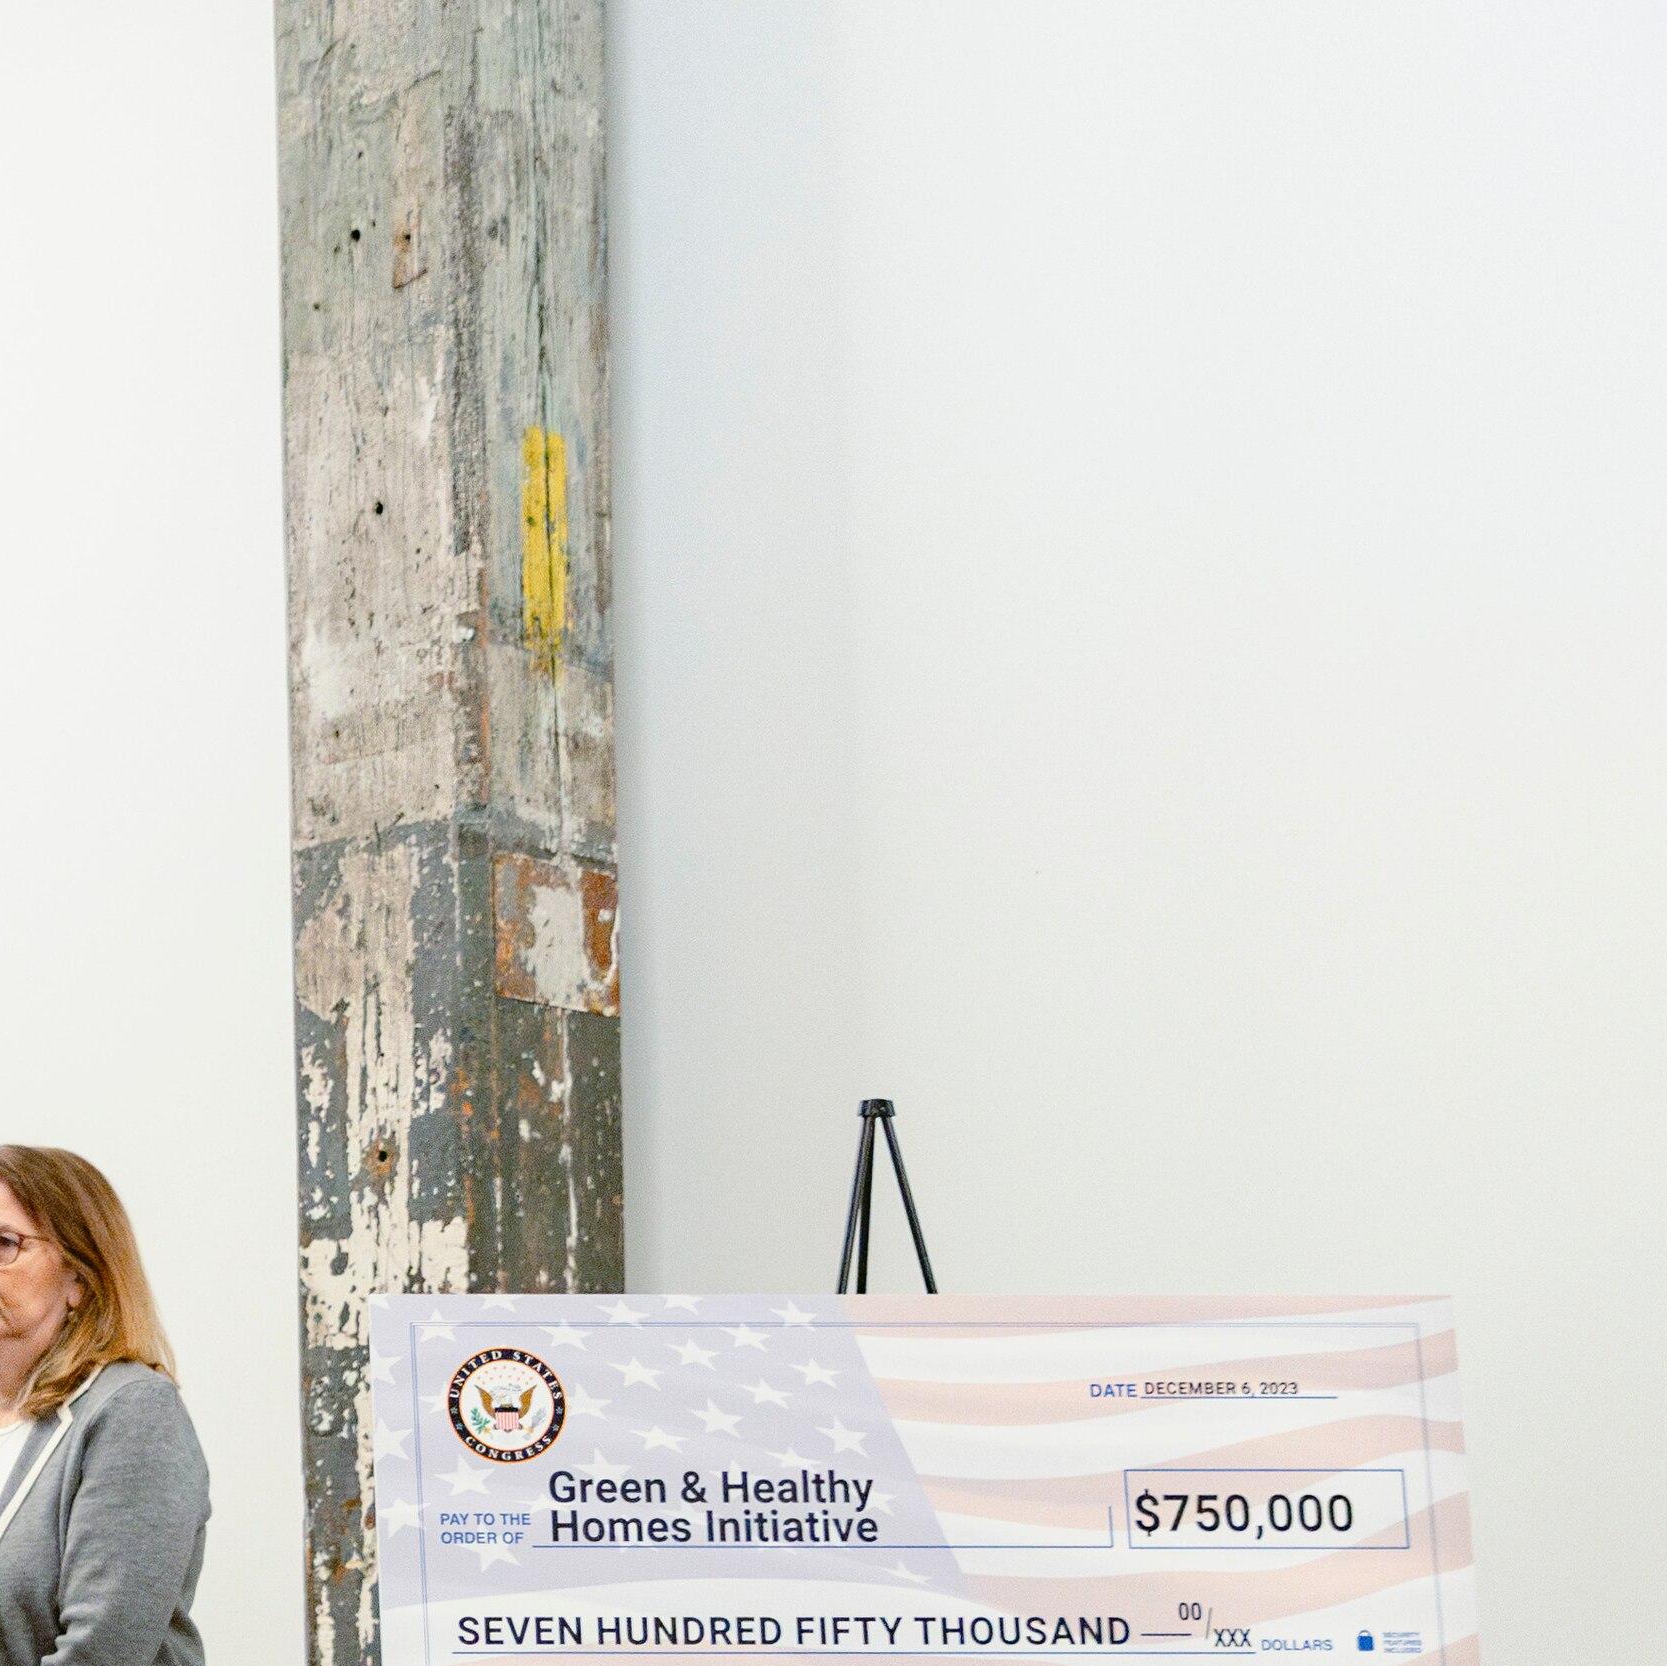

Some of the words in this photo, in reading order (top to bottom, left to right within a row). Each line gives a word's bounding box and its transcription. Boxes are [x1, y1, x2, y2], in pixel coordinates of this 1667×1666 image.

[449, 1350, 503, 1399] UNITED
[512, 1350, 563, 1400] STATES
[1090, 1383, 1138, 1398] DATE
[1144, 1381, 1236, 1395] DECEMBER
[1241, 1381, 1256, 1398] 6,
[1259, 1381, 1299, 1395] 2023
[465, 1434, 552, 1461] CONGRESS
[548, 1470, 667, 1504] Green
[680, 1470, 707, 1504] &
[721, 1469, 874, 1513] Healthy
[440, 1513, 468, 1526] PAY
[473, 1513, 495, 1526] TO
[499, 1513, 532, 1526] THE
[551, 1509, 693, 1543] Homes
[706, 1509, 880, 1543] Initiative
[1134, 1489, 1354, 1540] $750,000
[440, 1532, 496, 1545] ORDER
[501, 1532, 525, 1545] OF
[458, 1616, 583, 1646] SEVEN
[597, 1616, 782, 1646] HUNDRED
[796, 1616, 903, 1645] FIFTY
[913, 1616, 1130, 1646] THOUSAND
[1261, 1639, 1334, 1651] DOLLARS
